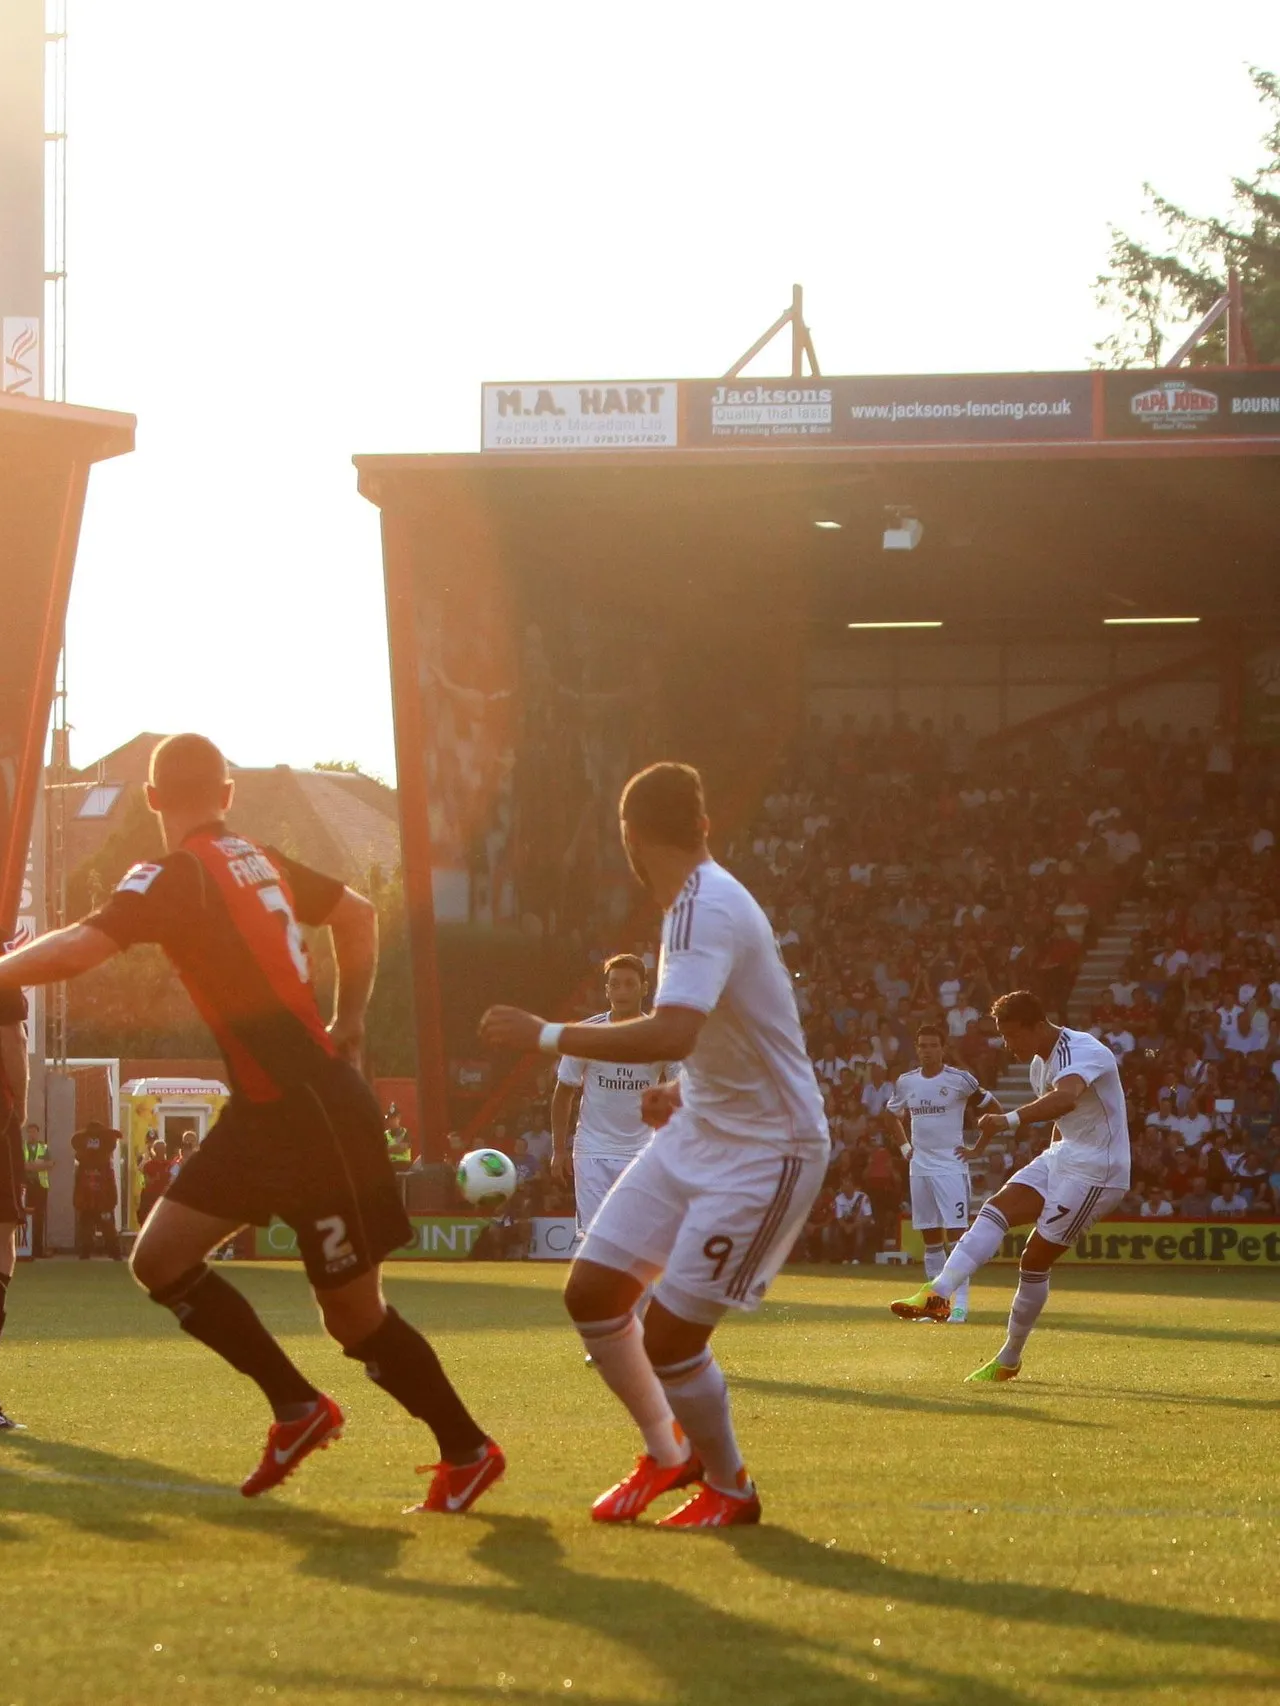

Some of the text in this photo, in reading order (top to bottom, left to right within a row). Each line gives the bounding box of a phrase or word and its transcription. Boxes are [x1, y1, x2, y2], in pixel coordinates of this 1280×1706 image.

[496, 386, 665, 418] M.A. HART
[711, 385, 832, 405] Jacksons
[1135, 391, 1168, 411] PAPA
[715, 406, 829, 422] Quality that lasts
[851, 398, 1072, 422] www.jacksons-fencing.co.uk
[597, 1075, 650, 1091] Emirates
[616, 1067, 634, 1080] Fly
[147, 1087, 220, 1096] PROGRAMMES
[954, 1201, 965, 1220] 3
[1045, 1203, 1071, 1225] 7
[315, 1214, 355, 1262] 2
[702, 1234, 734, 1282] 9
